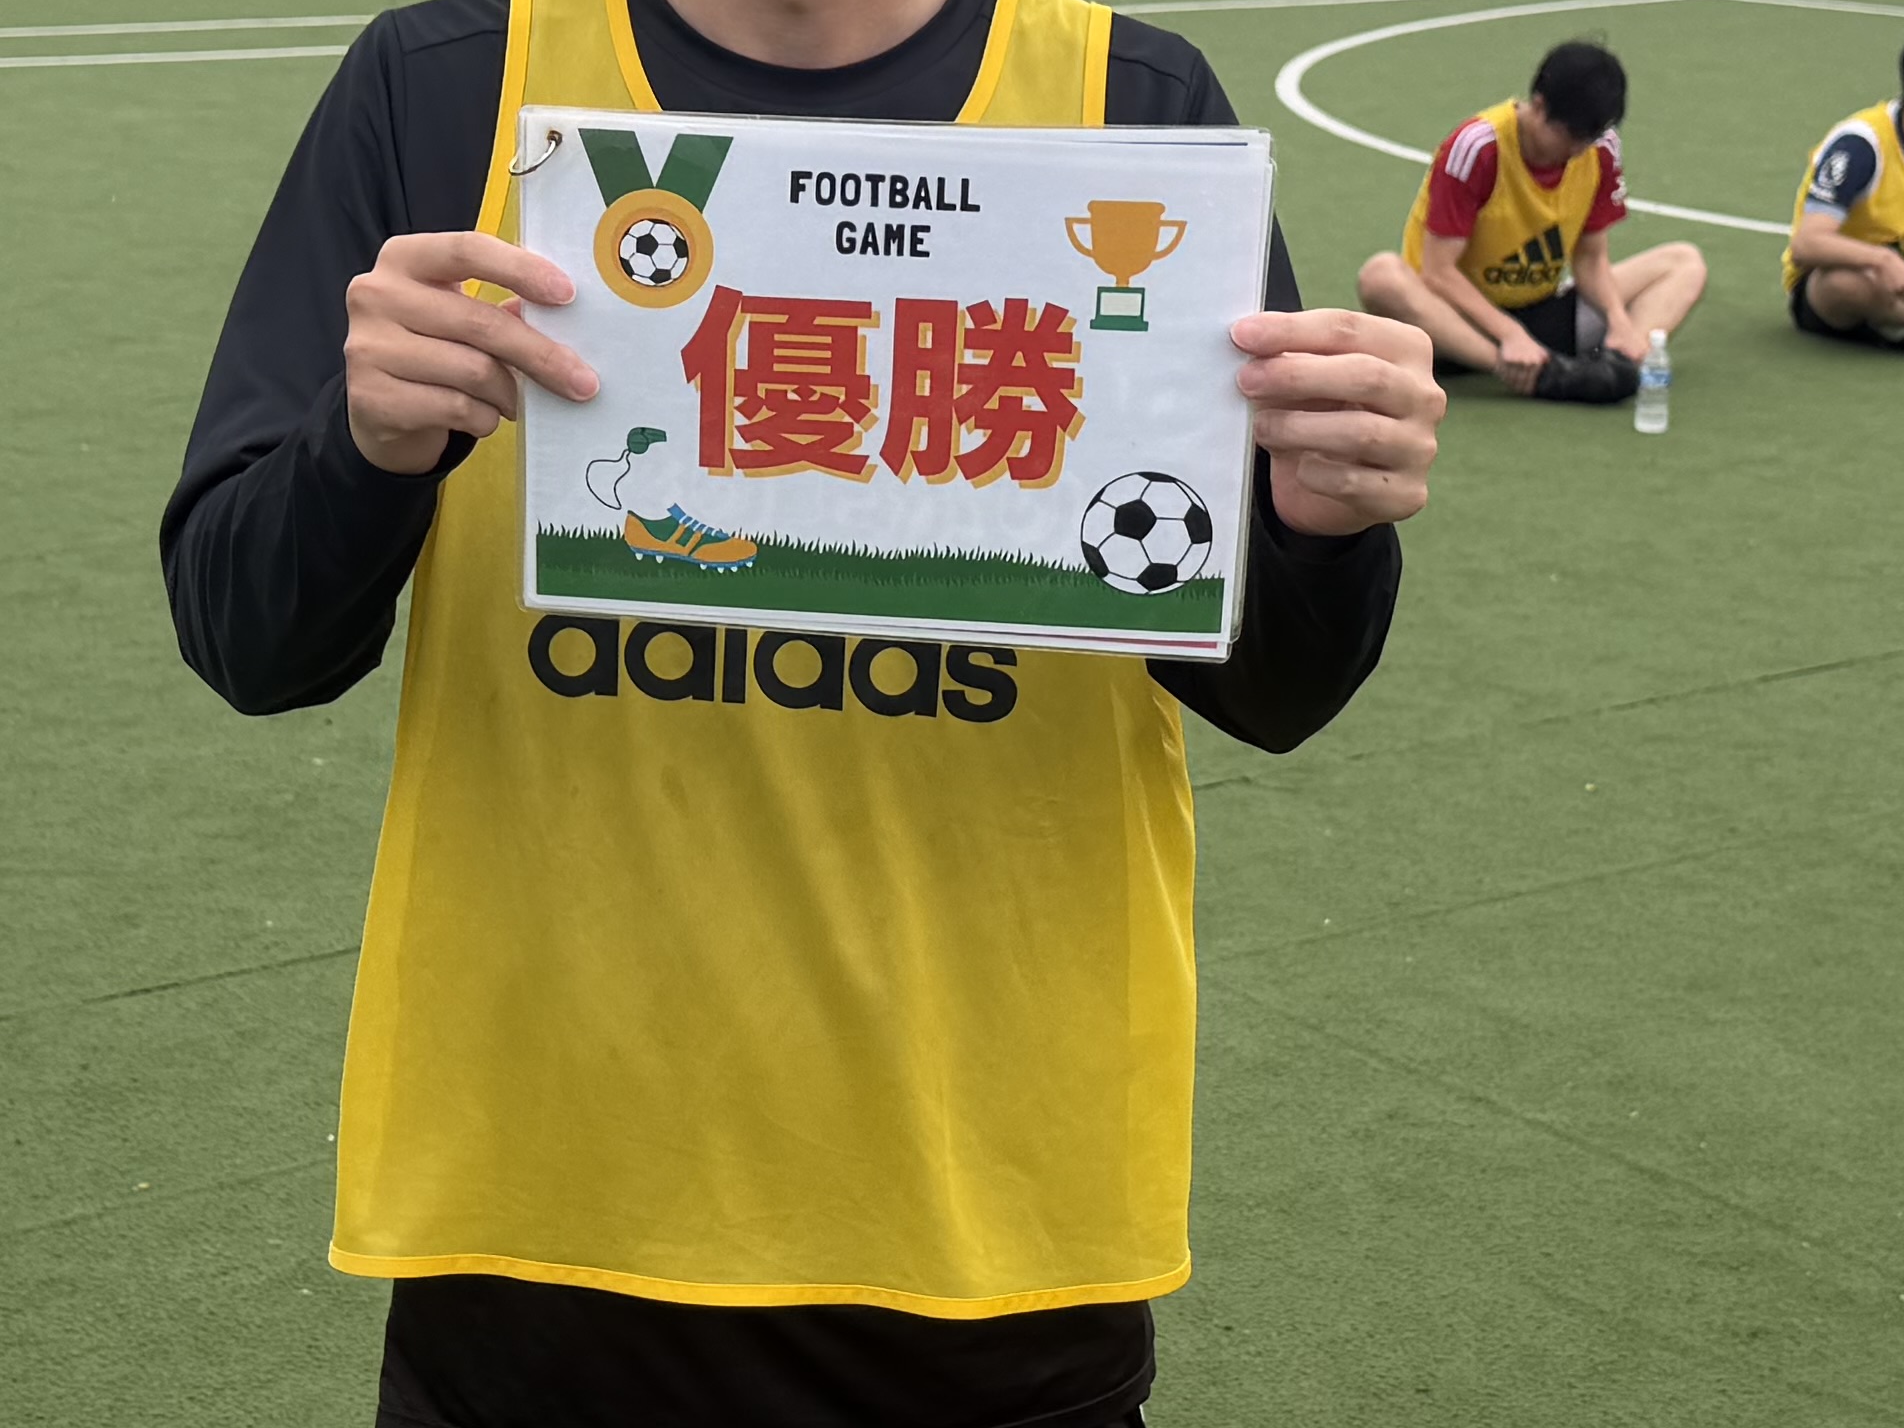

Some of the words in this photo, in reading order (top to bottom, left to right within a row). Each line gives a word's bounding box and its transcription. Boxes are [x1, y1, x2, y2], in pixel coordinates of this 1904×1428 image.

[789, 170, 981, 213] FOOTBALL
[835, 220, 931, 258] GAME
[680, 284, 1085, 489] 優勝
[527, 614, 1018, 723] adidas
